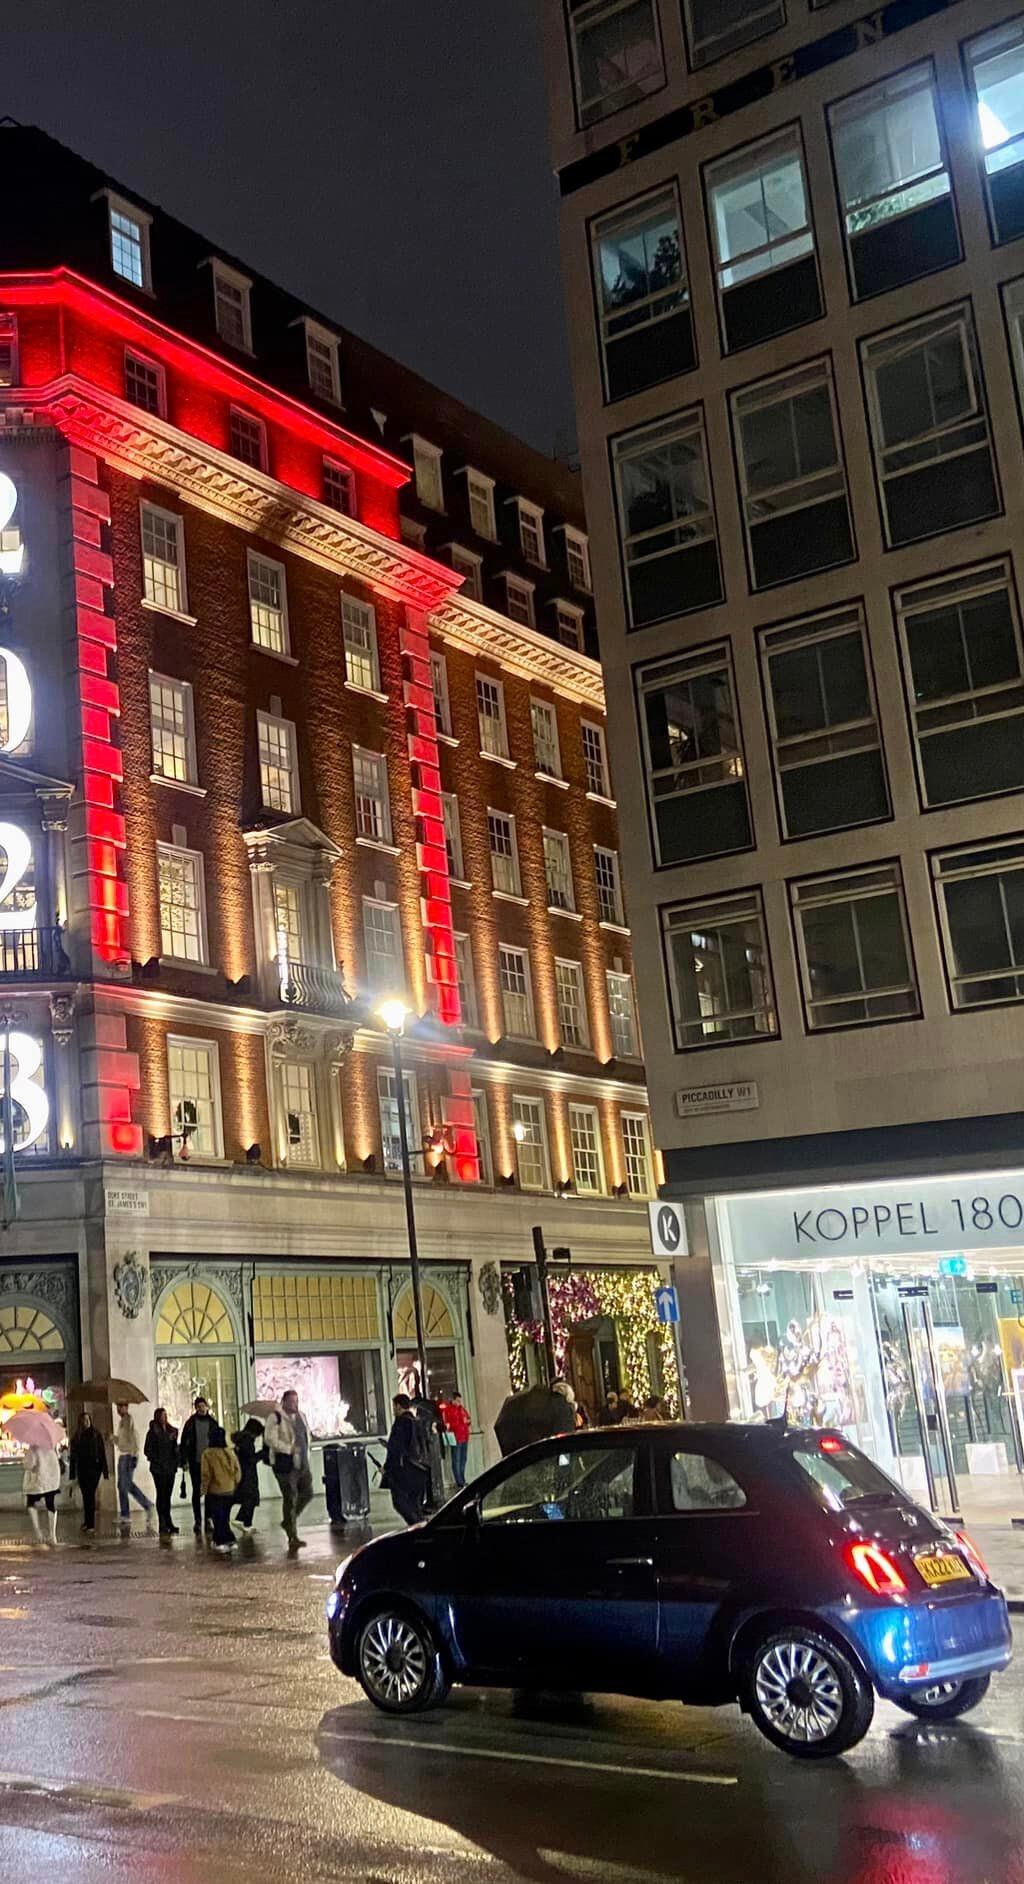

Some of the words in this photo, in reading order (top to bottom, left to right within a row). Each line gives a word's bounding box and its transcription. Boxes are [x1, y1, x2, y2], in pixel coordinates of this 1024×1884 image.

[682, 1087, 734, 1103] PICCADILLY
[793, 1202, 939, 1244] KOPPEL
[951, 1194, 1023, 1232] 180
